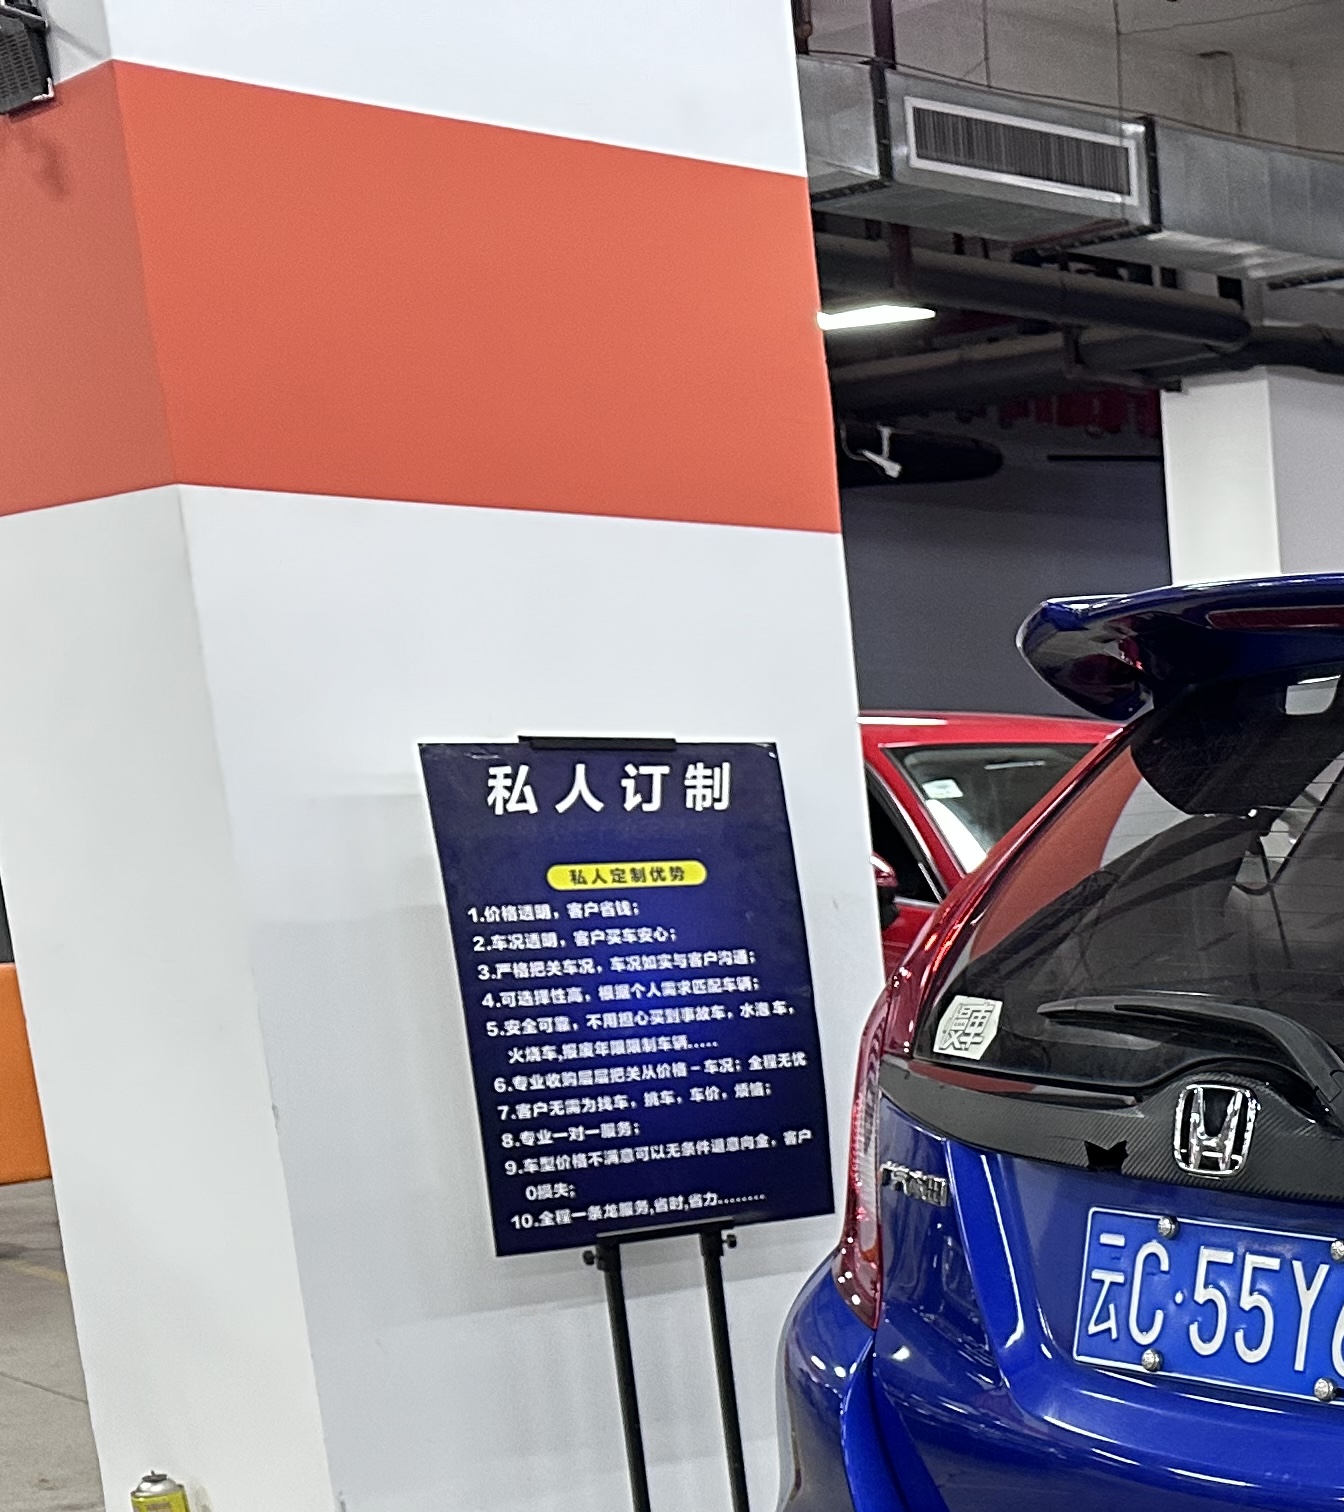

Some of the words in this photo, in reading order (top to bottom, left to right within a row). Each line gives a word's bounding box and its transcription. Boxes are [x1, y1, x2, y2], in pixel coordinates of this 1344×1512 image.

[487, 762, 730, 816] 私人订制
[569, 866, 685, 886] 私人定制优势
